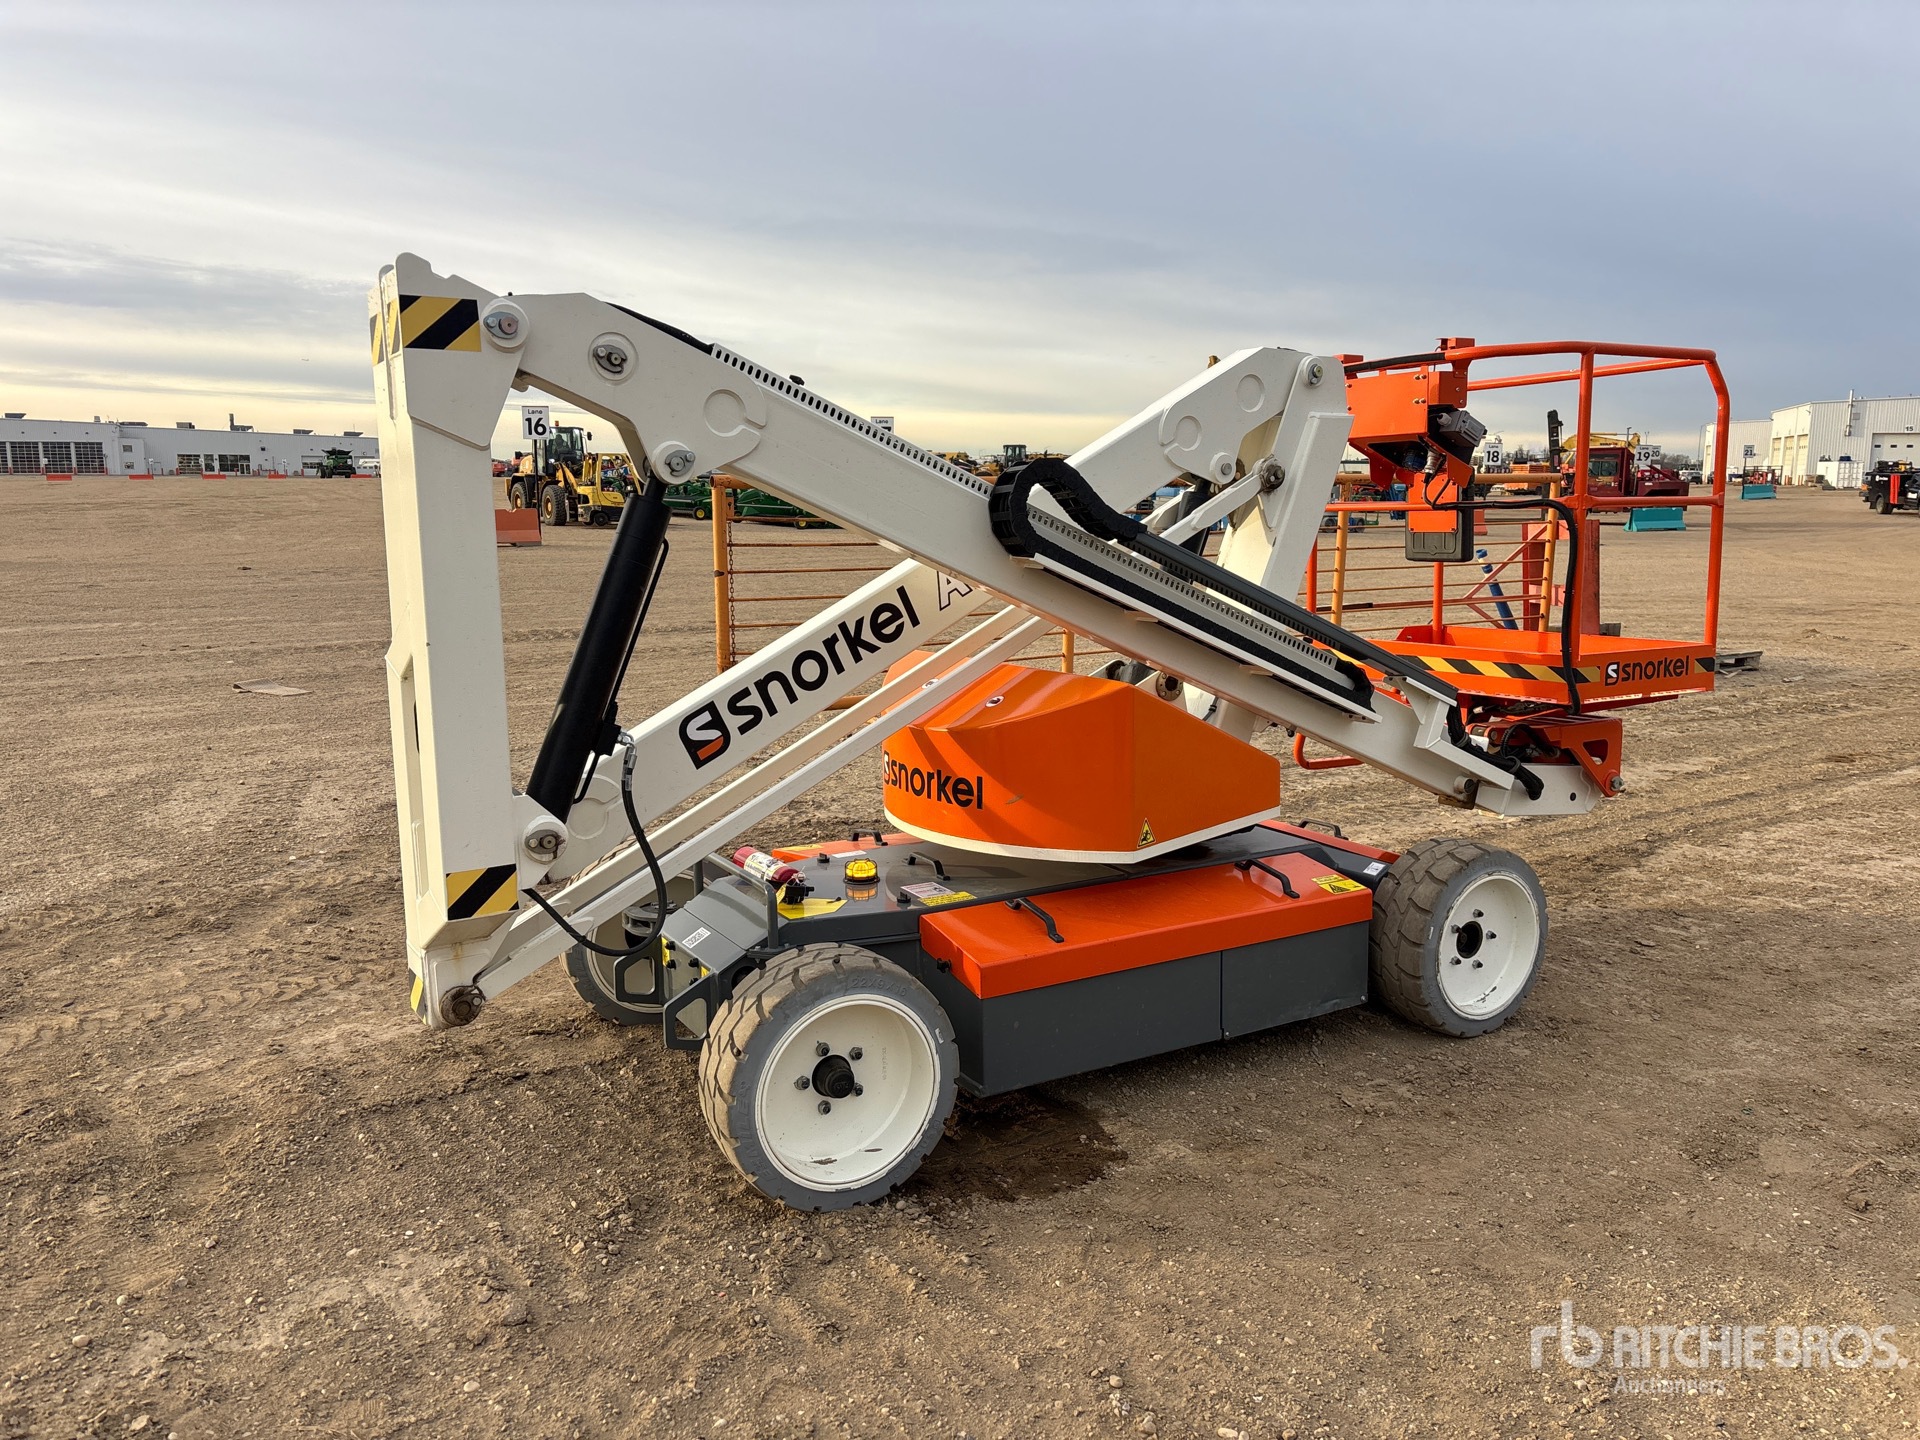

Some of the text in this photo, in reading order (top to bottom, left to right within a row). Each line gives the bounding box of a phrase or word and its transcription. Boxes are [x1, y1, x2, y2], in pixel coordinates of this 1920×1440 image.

[525, 417, 547, 436] 16
[1486, 450, 1500, 463] 18
[1636, 451, 1651, 462] 19
[1651, 450, 1660, 458] 20
[727, 585, 921, 736] snorkel
[1621, 655, 1690, 682] snorkel
[890, 758, 984, 810] snorkel
